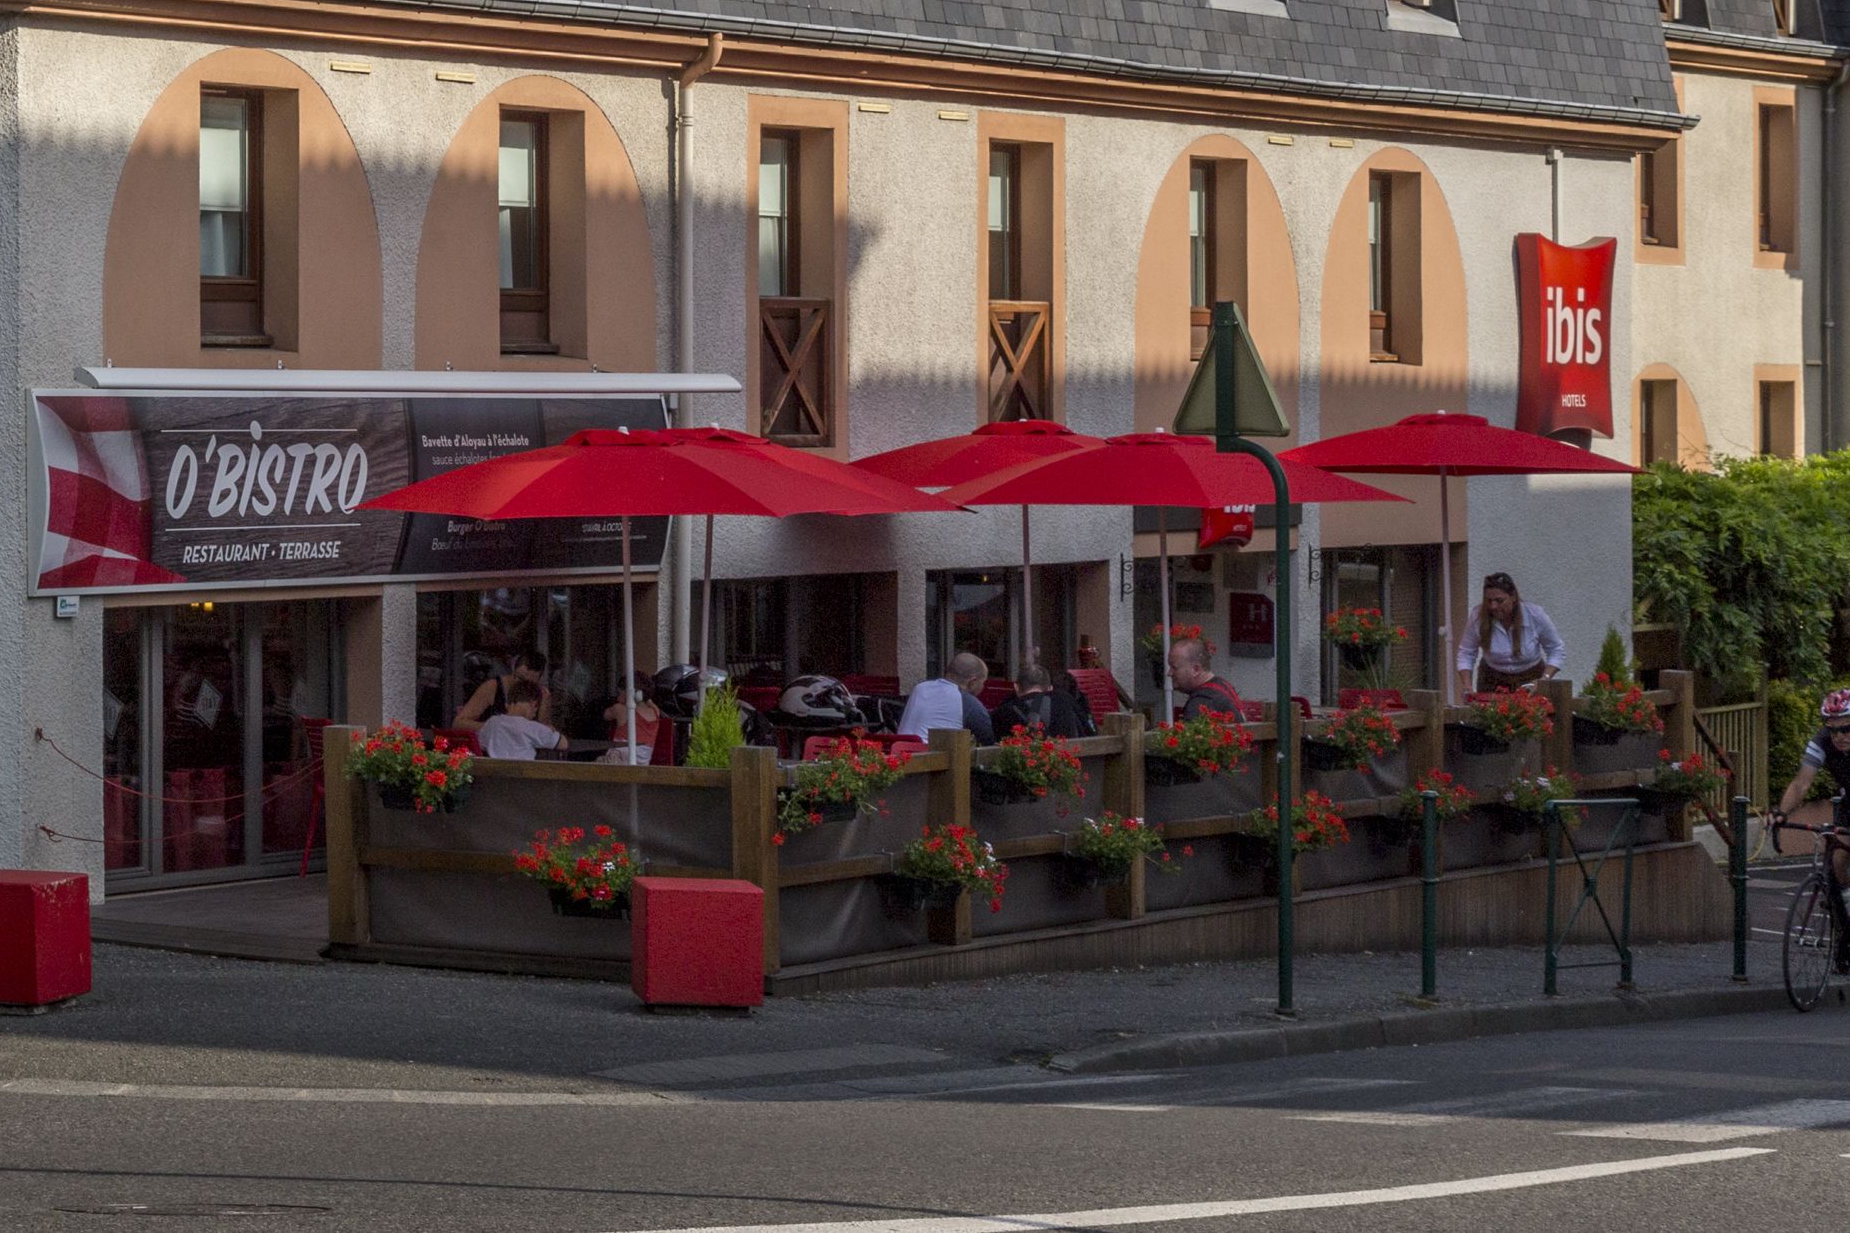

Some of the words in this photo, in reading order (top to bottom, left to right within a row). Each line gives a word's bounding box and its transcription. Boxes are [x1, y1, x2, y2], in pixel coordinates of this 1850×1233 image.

[1547, 287, 1602, 364] ibis
[1561, 394, 1586, 407] HOTELS
[421, 435, 452, 447] Bavette
[454, 434, 486, 450] d'Aloyau
[493, 433, 530, 446] l'échalote
[432, 456, 453, 465] sauce
[183, 543, 270, 564] RESTAURANT
[279, 541, 341, 560] TERRASSE
